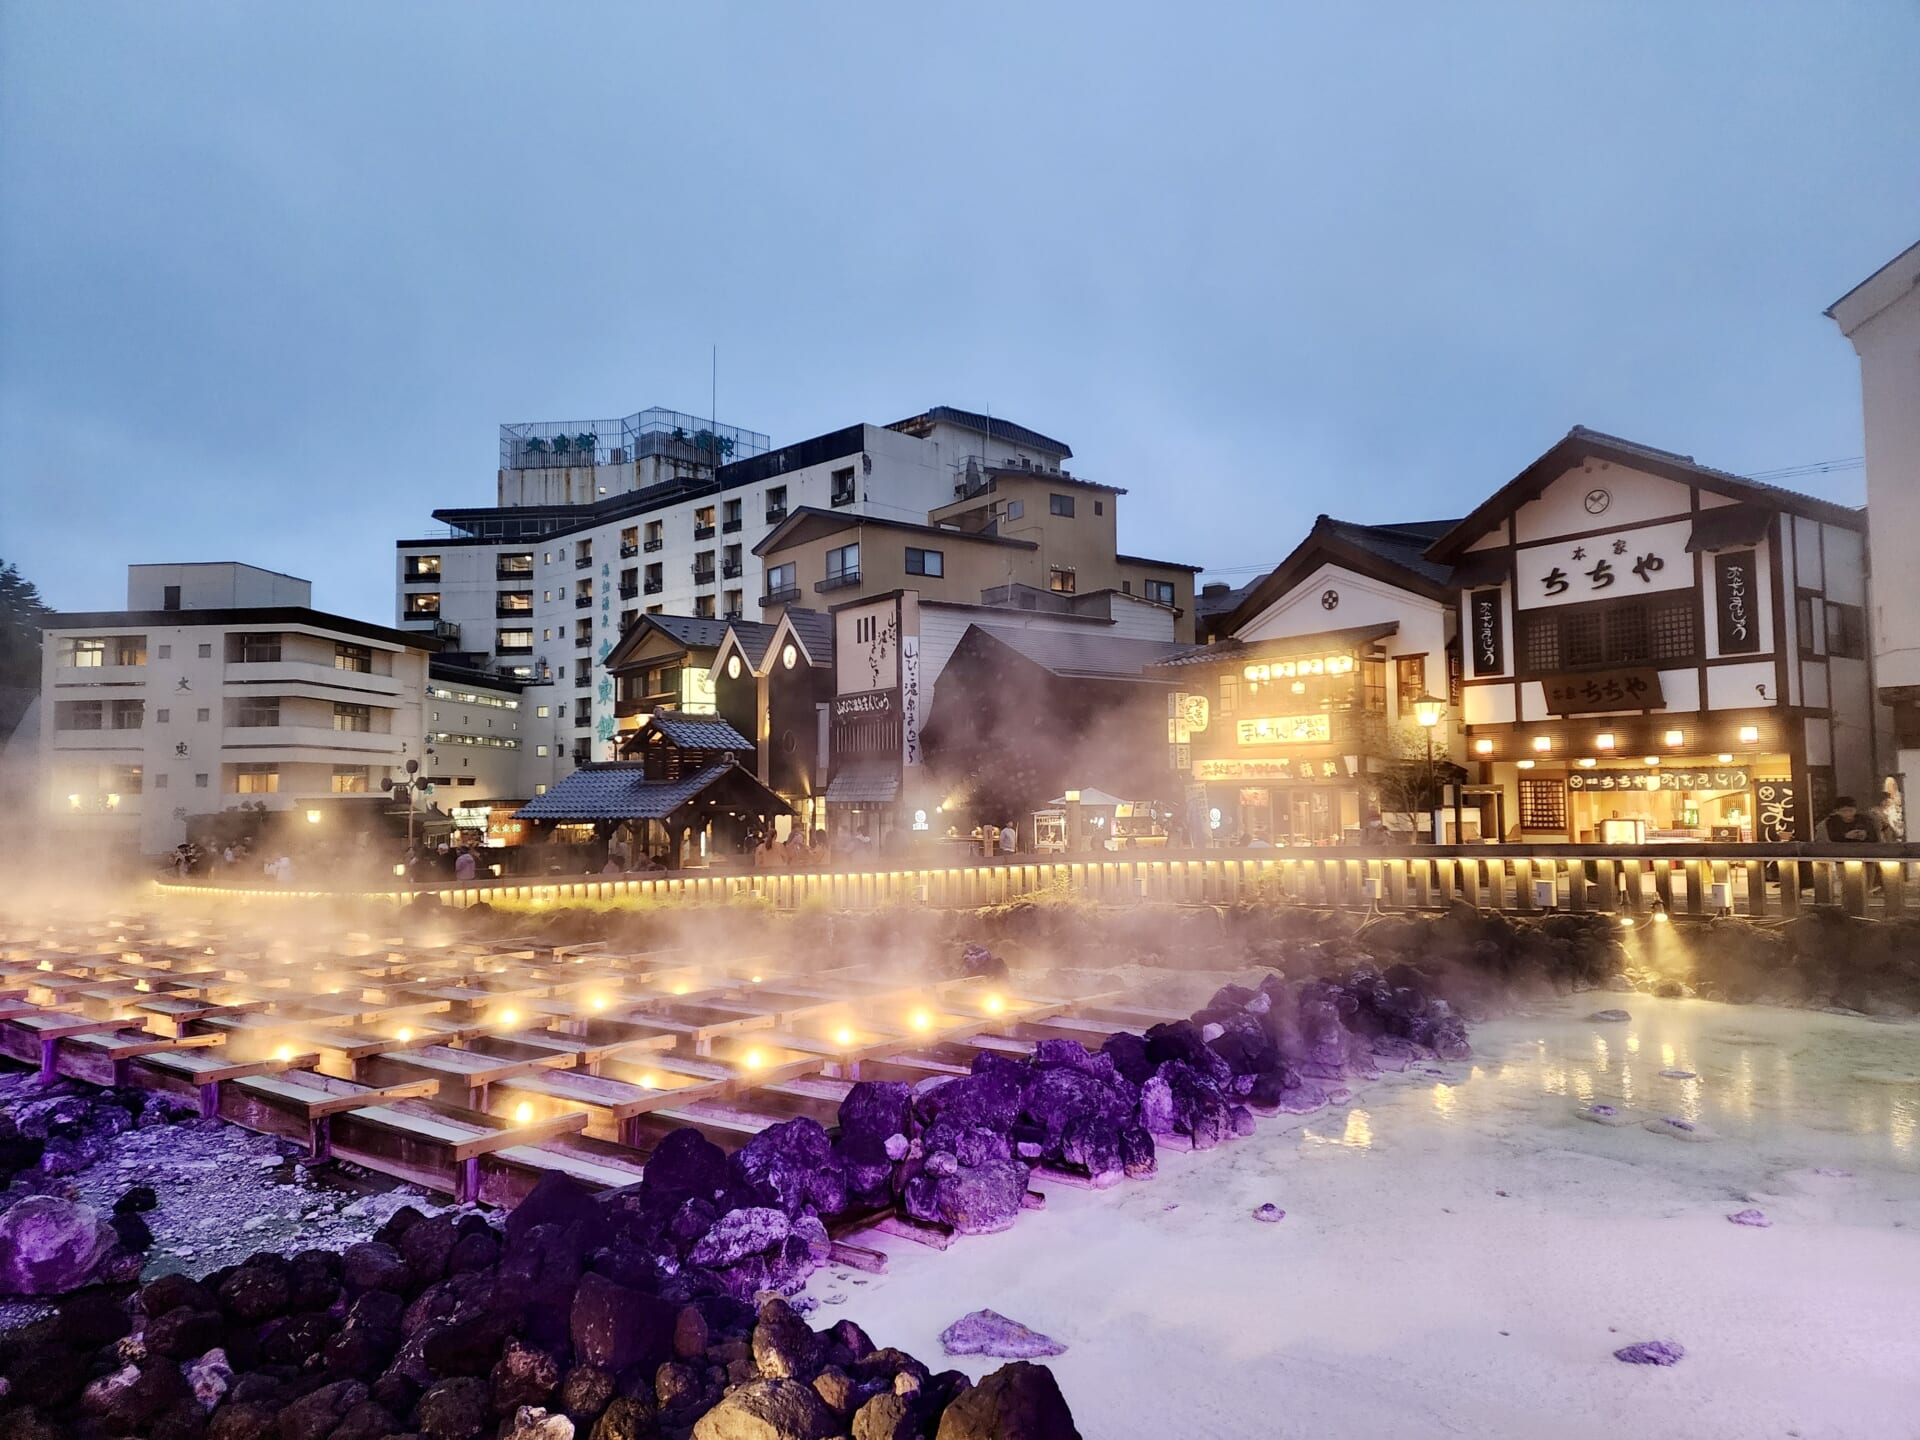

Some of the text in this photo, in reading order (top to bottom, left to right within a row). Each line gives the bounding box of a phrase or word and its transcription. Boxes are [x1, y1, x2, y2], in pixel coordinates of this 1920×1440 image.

[1571, 539, 1628, 561] 本家
[1541, 552, 1664, 597] ちちや
[1580, 676, 1648, 705] ちちや
